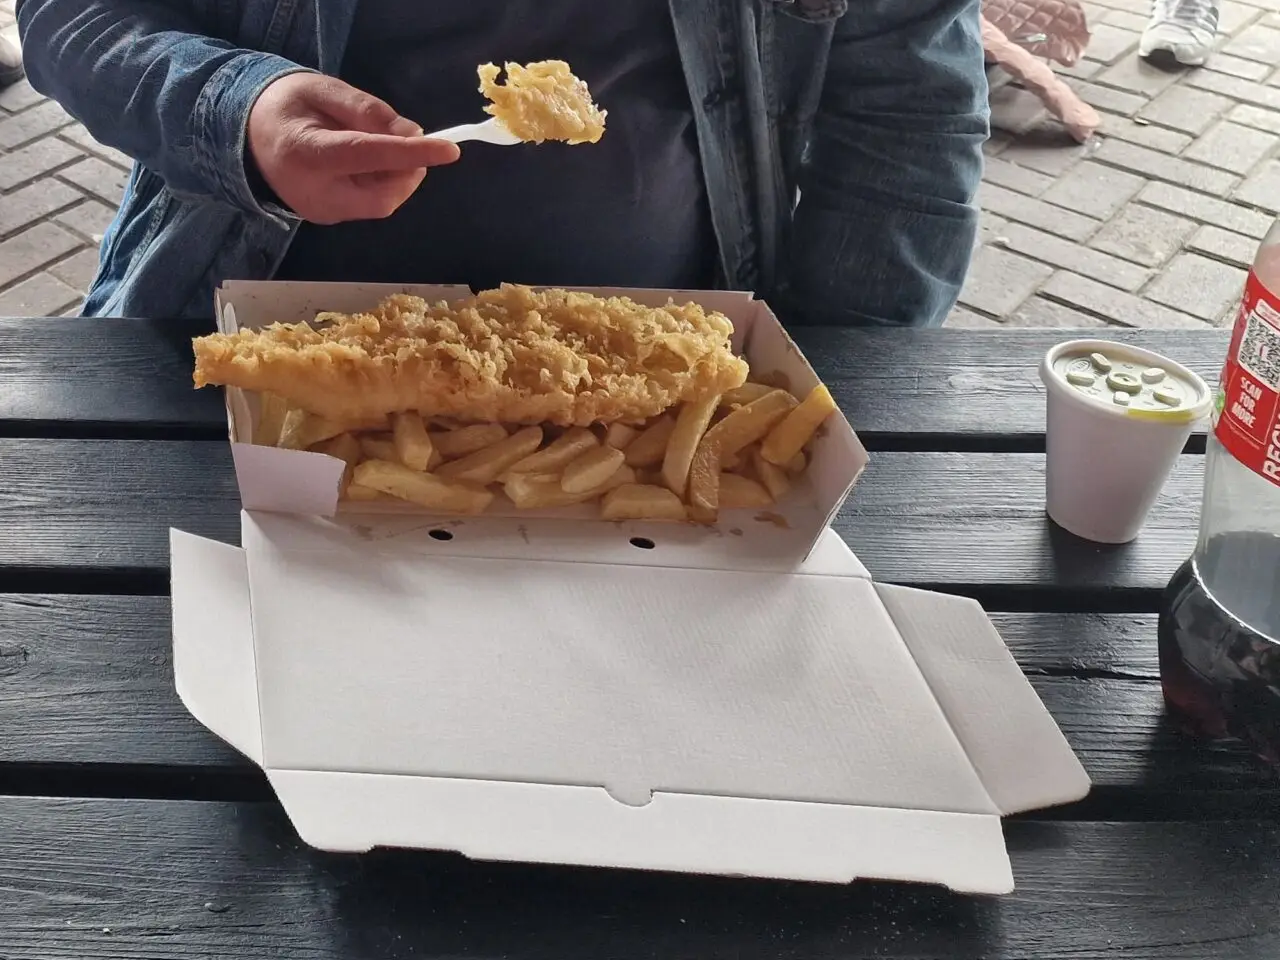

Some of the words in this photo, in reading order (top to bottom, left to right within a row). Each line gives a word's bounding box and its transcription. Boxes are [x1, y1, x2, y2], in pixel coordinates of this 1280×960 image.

[1240, 376, 1263, 401] SCAN
[1239, 391, 1256, 413] FOR
[1231, 401, 1257, 429] MORE
